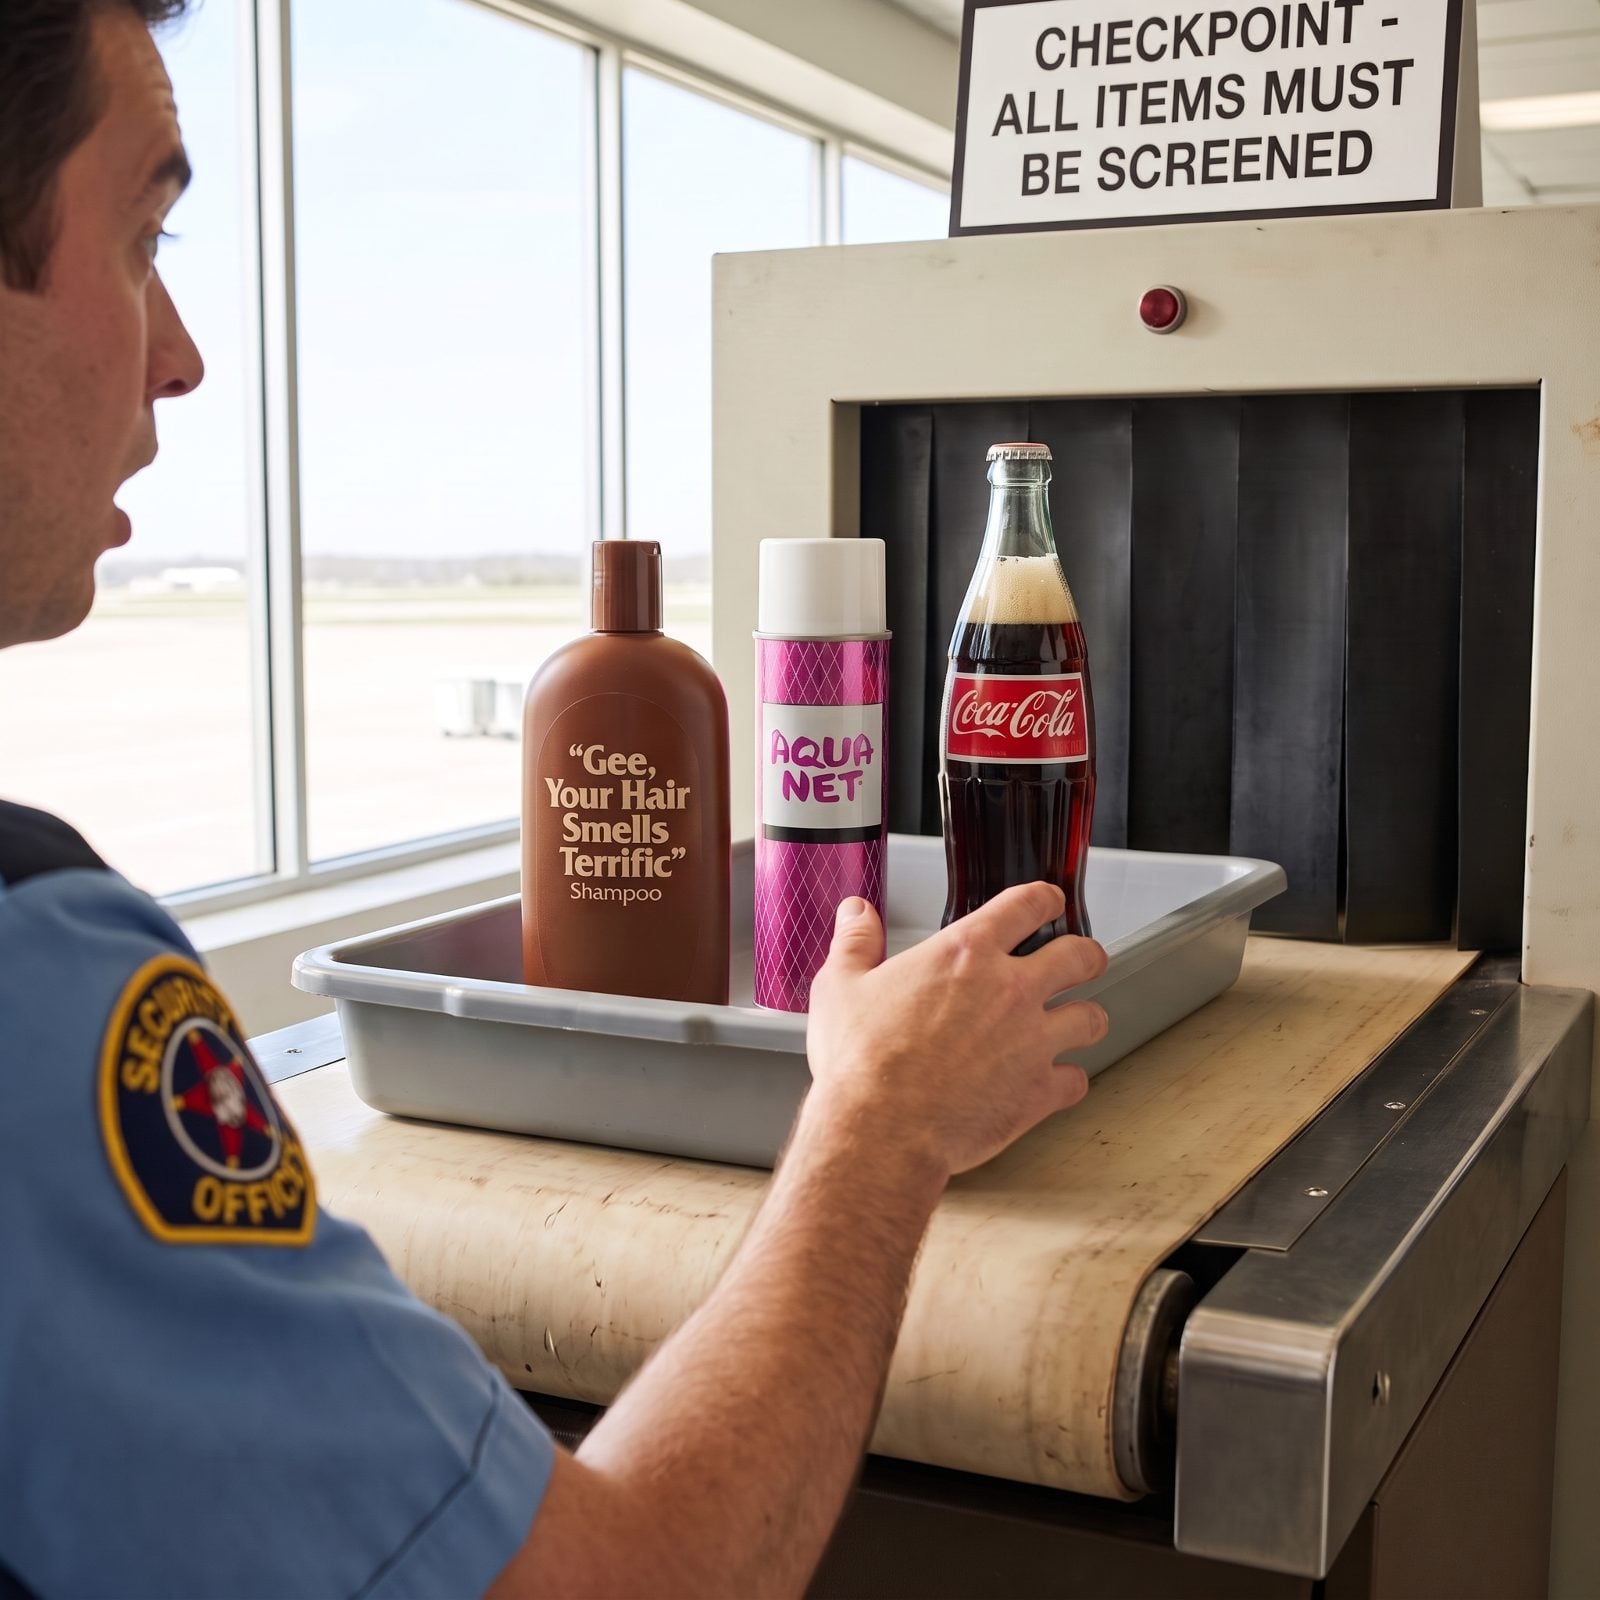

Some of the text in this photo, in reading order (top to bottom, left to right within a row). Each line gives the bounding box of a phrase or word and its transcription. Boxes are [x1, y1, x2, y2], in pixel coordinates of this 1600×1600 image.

[1036, 0, 1364, 71] CHECKPOINT
[992, 58, 1414, 137] ALL ITEMS MUST
[1021, 130, 1373, 196] BE SCREENED
[952, 688, 1078, 738] Coca-Cola
[569, 744, 656, 780] “Gee,
[771, 728, 874, 769] AQUA
[544, 778, 690, 810] Your Hair
[782, 770, 863, 803] NET
[562, 813, 669, 843] Smells
[559, 847, 686, 877] Terrific”
[570, 882, 662, 906] Shampoo
